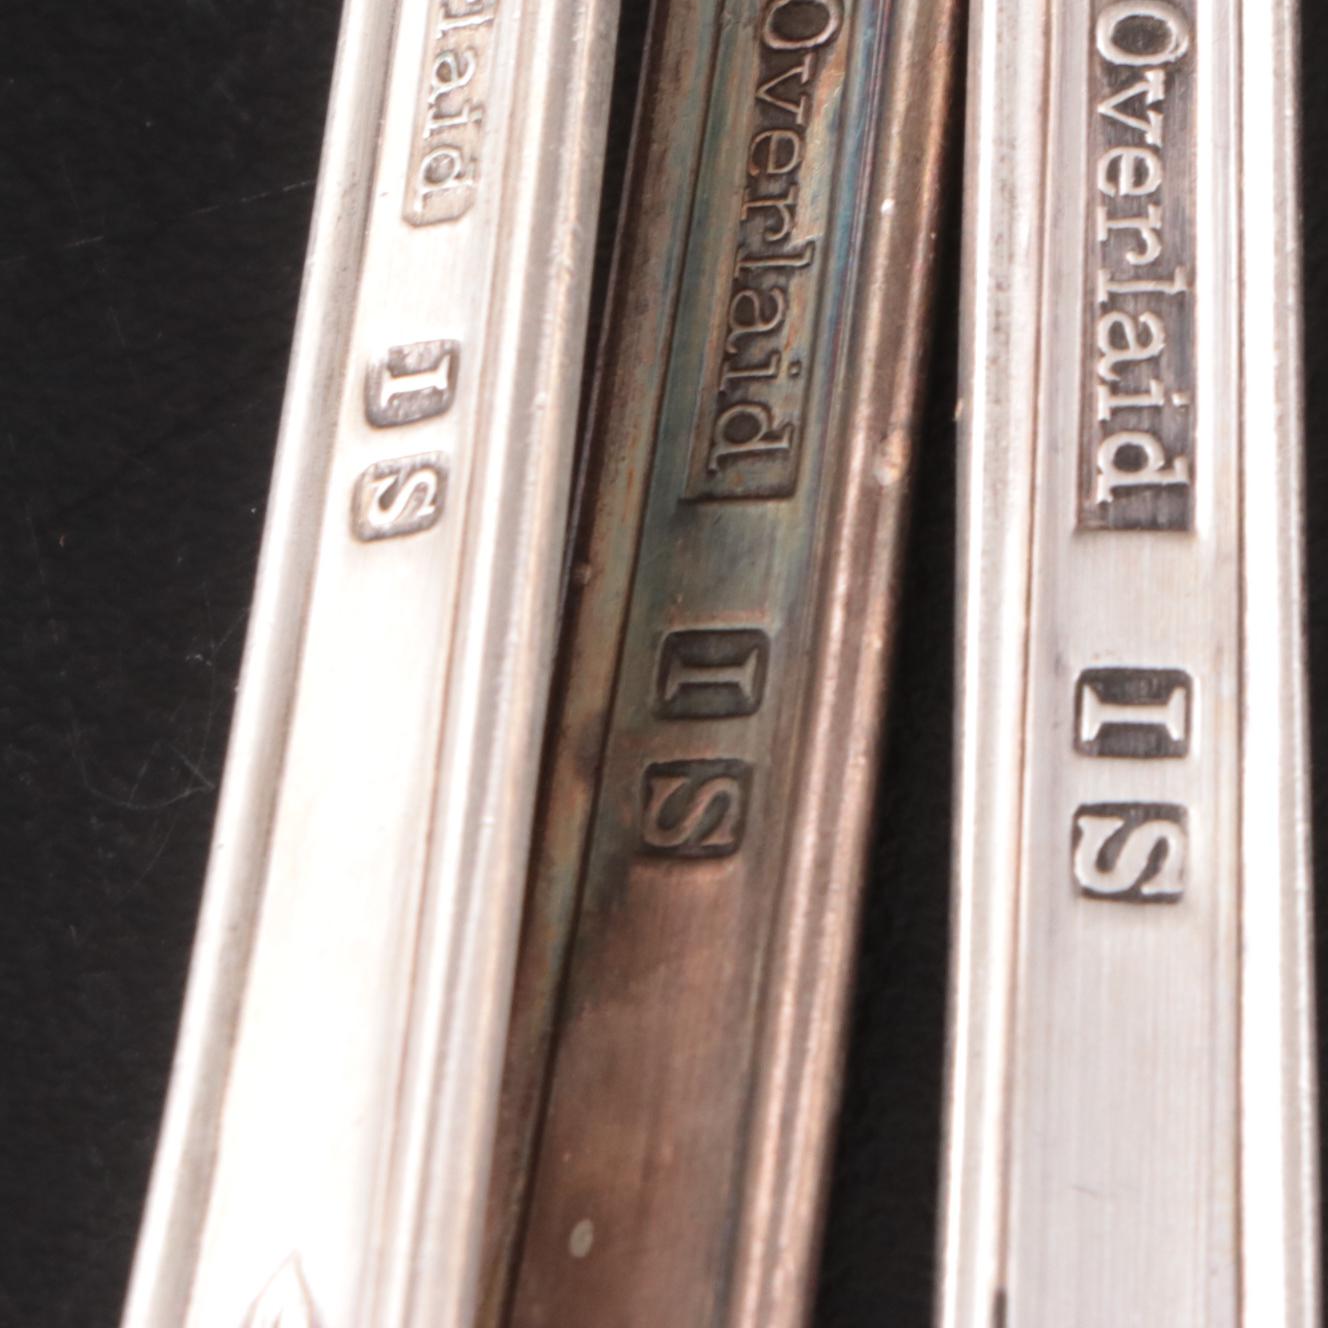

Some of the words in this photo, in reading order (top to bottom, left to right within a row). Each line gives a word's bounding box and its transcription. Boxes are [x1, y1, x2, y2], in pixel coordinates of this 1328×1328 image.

[376, 356, 450, 407] I
[364, 470, 440, 530] S
[662, 646, 762, 702] I
[1080, 684, 1186, 742] I
[646, 773, 746, 848] S
[1075, 814, 1185, 896] S
